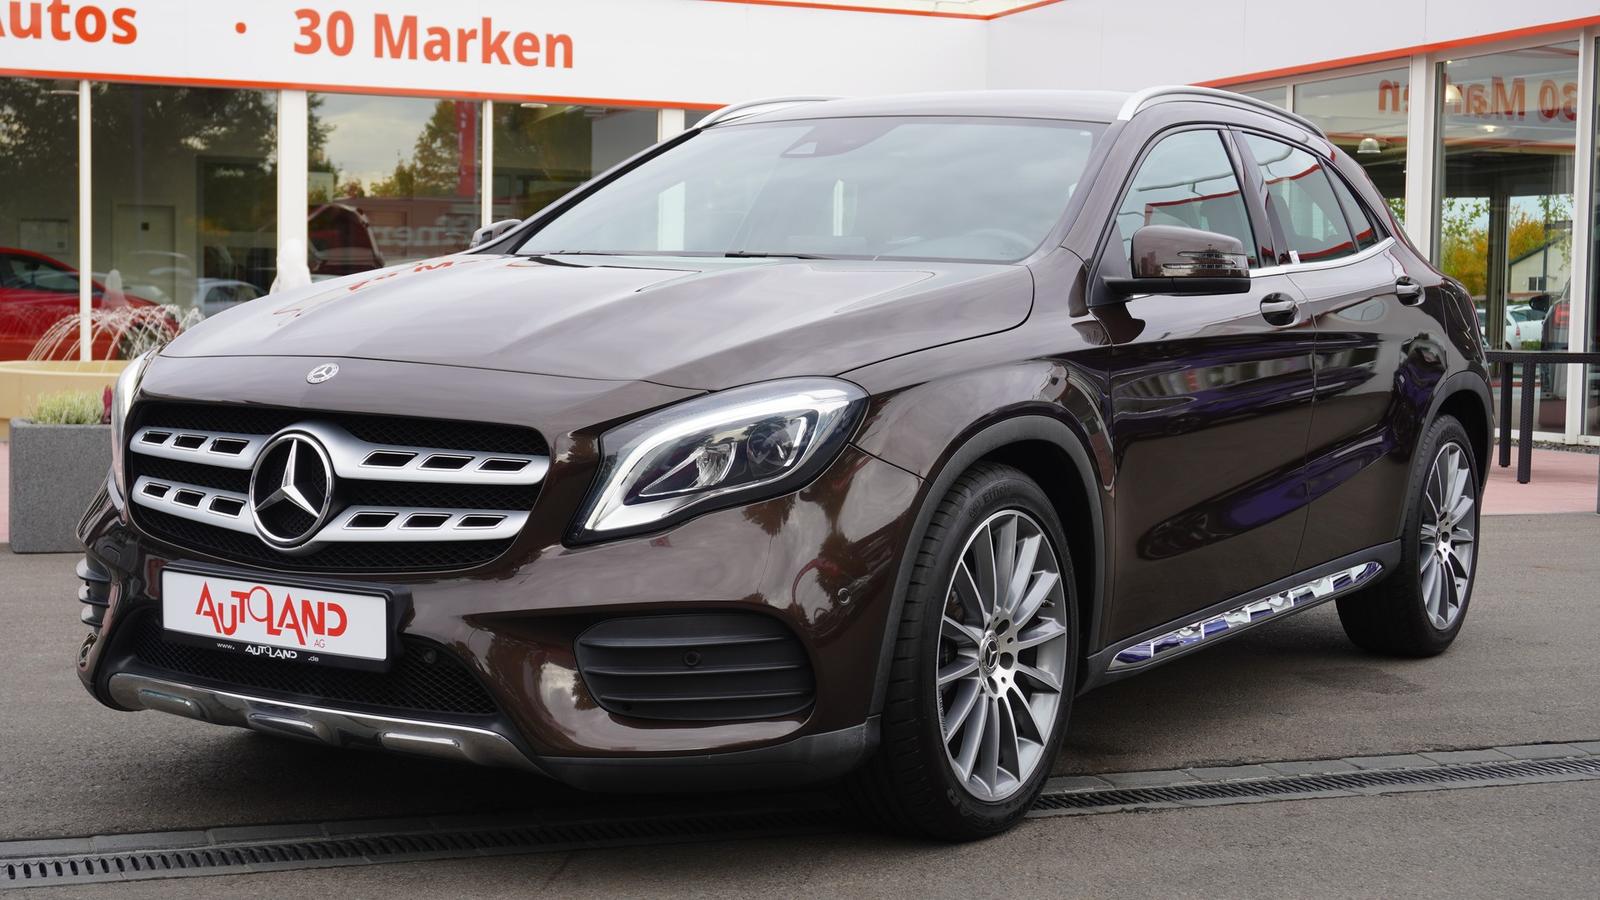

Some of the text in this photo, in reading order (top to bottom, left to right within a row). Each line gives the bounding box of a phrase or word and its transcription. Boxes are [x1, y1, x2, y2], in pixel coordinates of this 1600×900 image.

[0, 0, 573, 68] utos 30 Marken
[195, 581, 348, 645] AUTOLAND
[313, 639, 326, 649] AG
